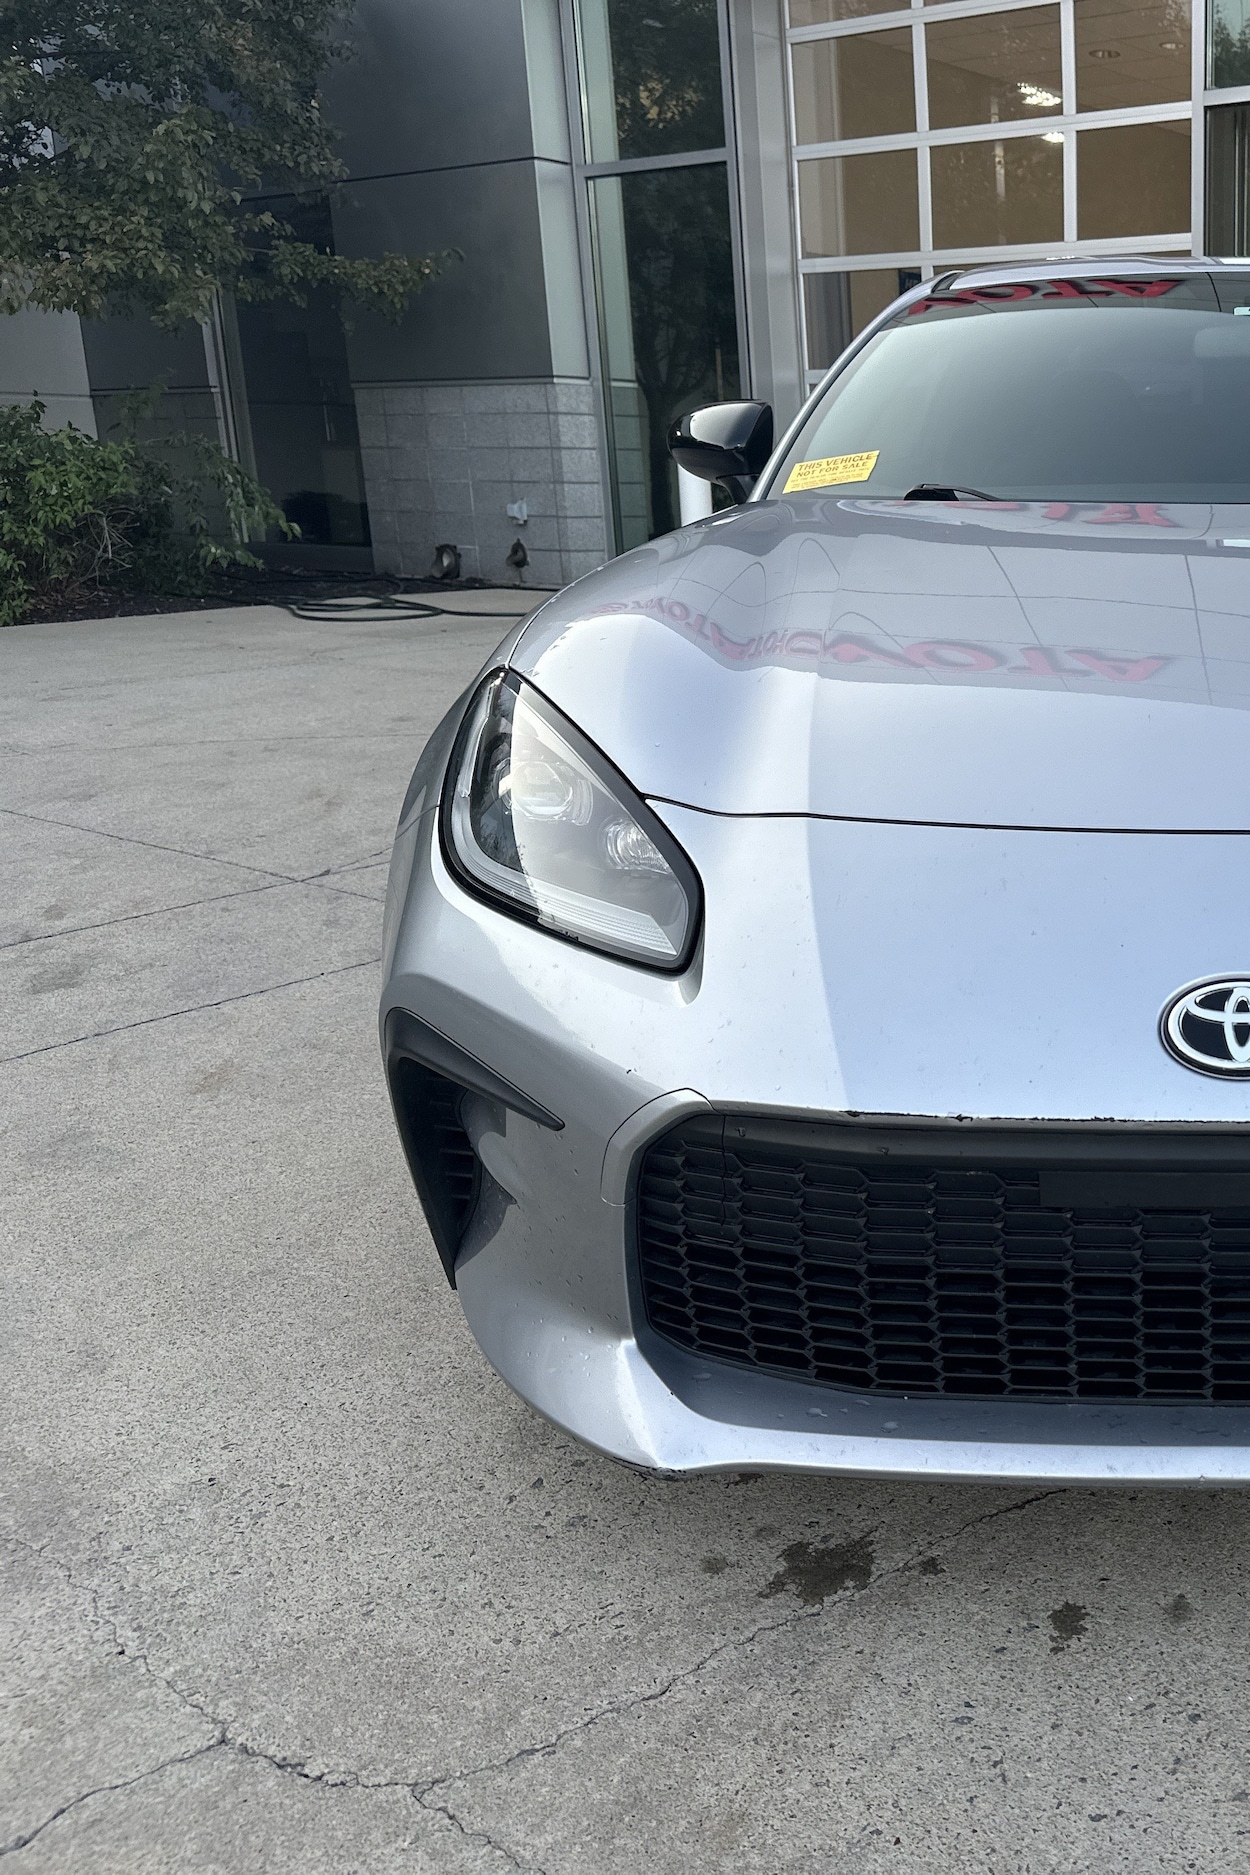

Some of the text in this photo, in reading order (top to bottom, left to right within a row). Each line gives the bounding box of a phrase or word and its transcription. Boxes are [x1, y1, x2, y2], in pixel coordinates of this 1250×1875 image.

[798, 454, 873, 471] THIS VEHICLE
[842, 461, 868, 470] SALE
